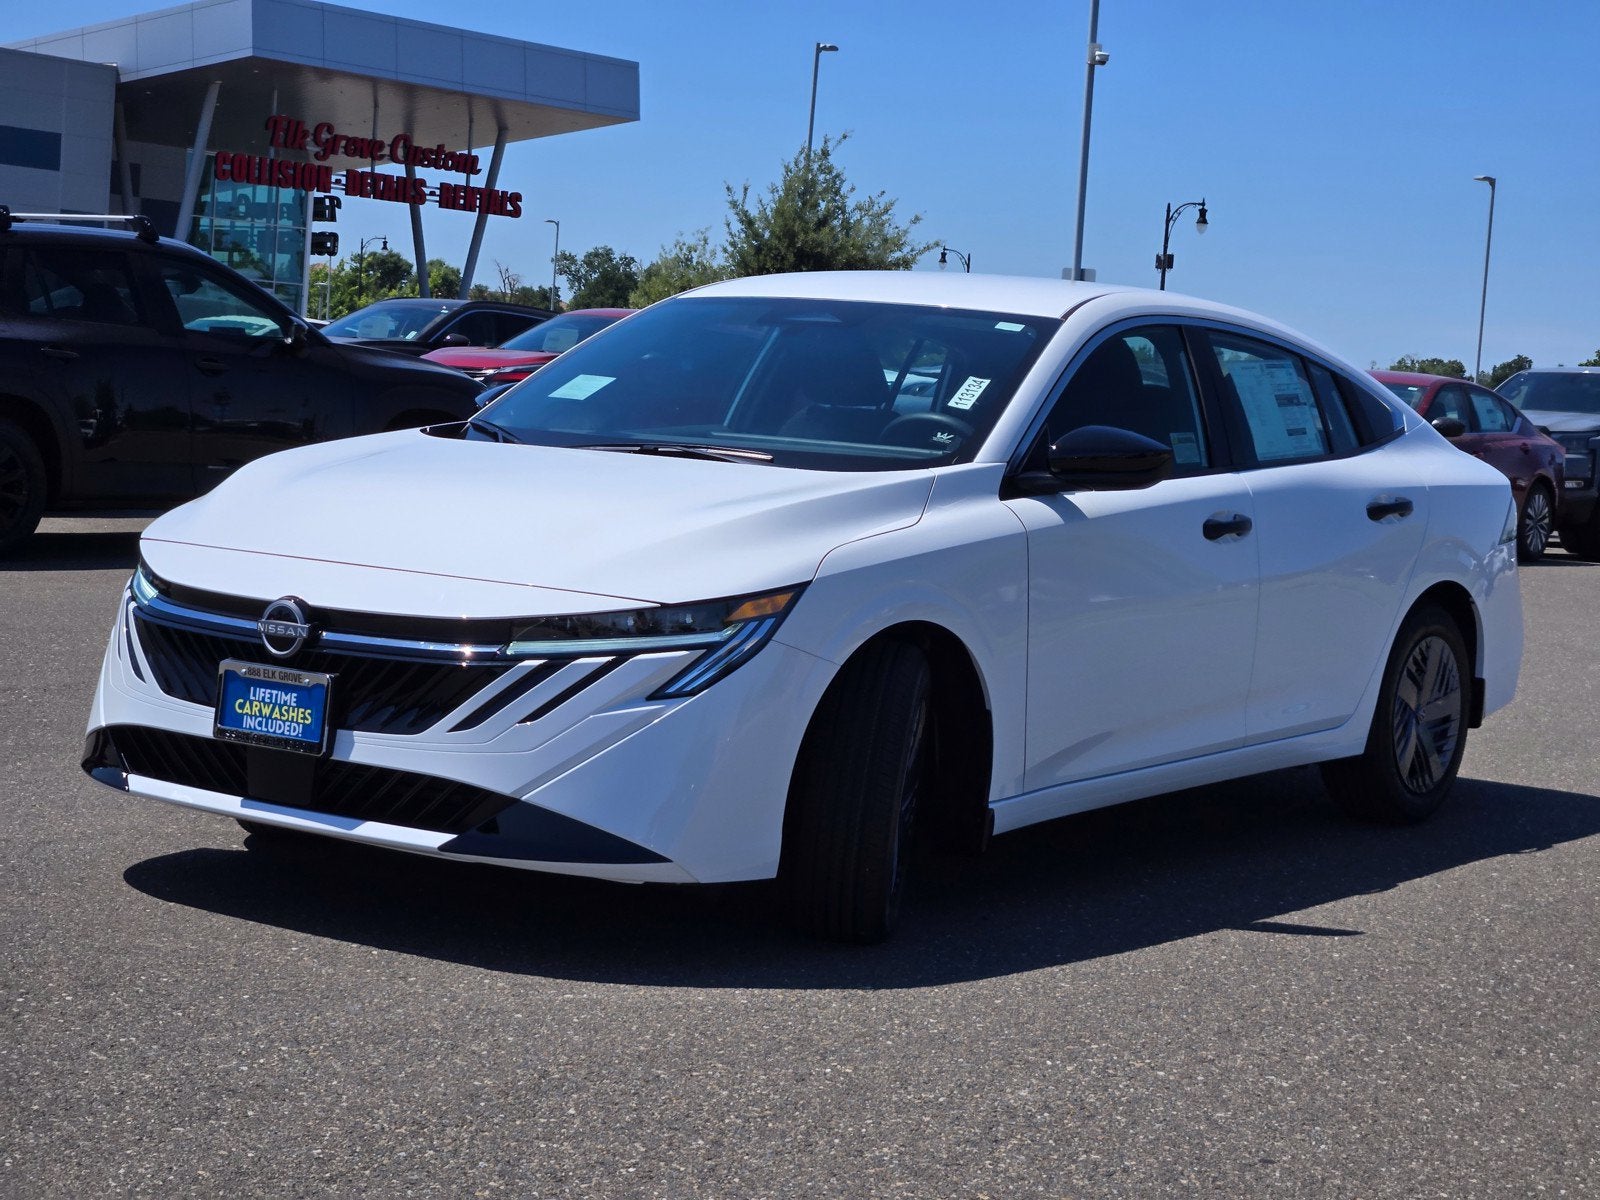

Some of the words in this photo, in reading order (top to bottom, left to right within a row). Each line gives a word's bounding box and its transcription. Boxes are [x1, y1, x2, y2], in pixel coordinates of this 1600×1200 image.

[265, 115, 311, 150] Elk
[313, 122, 388, 162] Grove
[390, 133, 482, 175] Custom
[215, 151, 333, 194] COLLISION
[345, 169, 427, 206] DETAILS
[438, 183, 523, 218] RENTALS
[954, 379, 985, 406] 113134
[257, 623, 307, 637] NISSAN
[263, 669, 276, 680] ELK
[278, 672, 303, 684] GROVE
[250, 686, 298, 706] LIFETIME
[235, 699, 312, 725] CARWASHES
[243, 716, 303, 738] INCLUDED!
